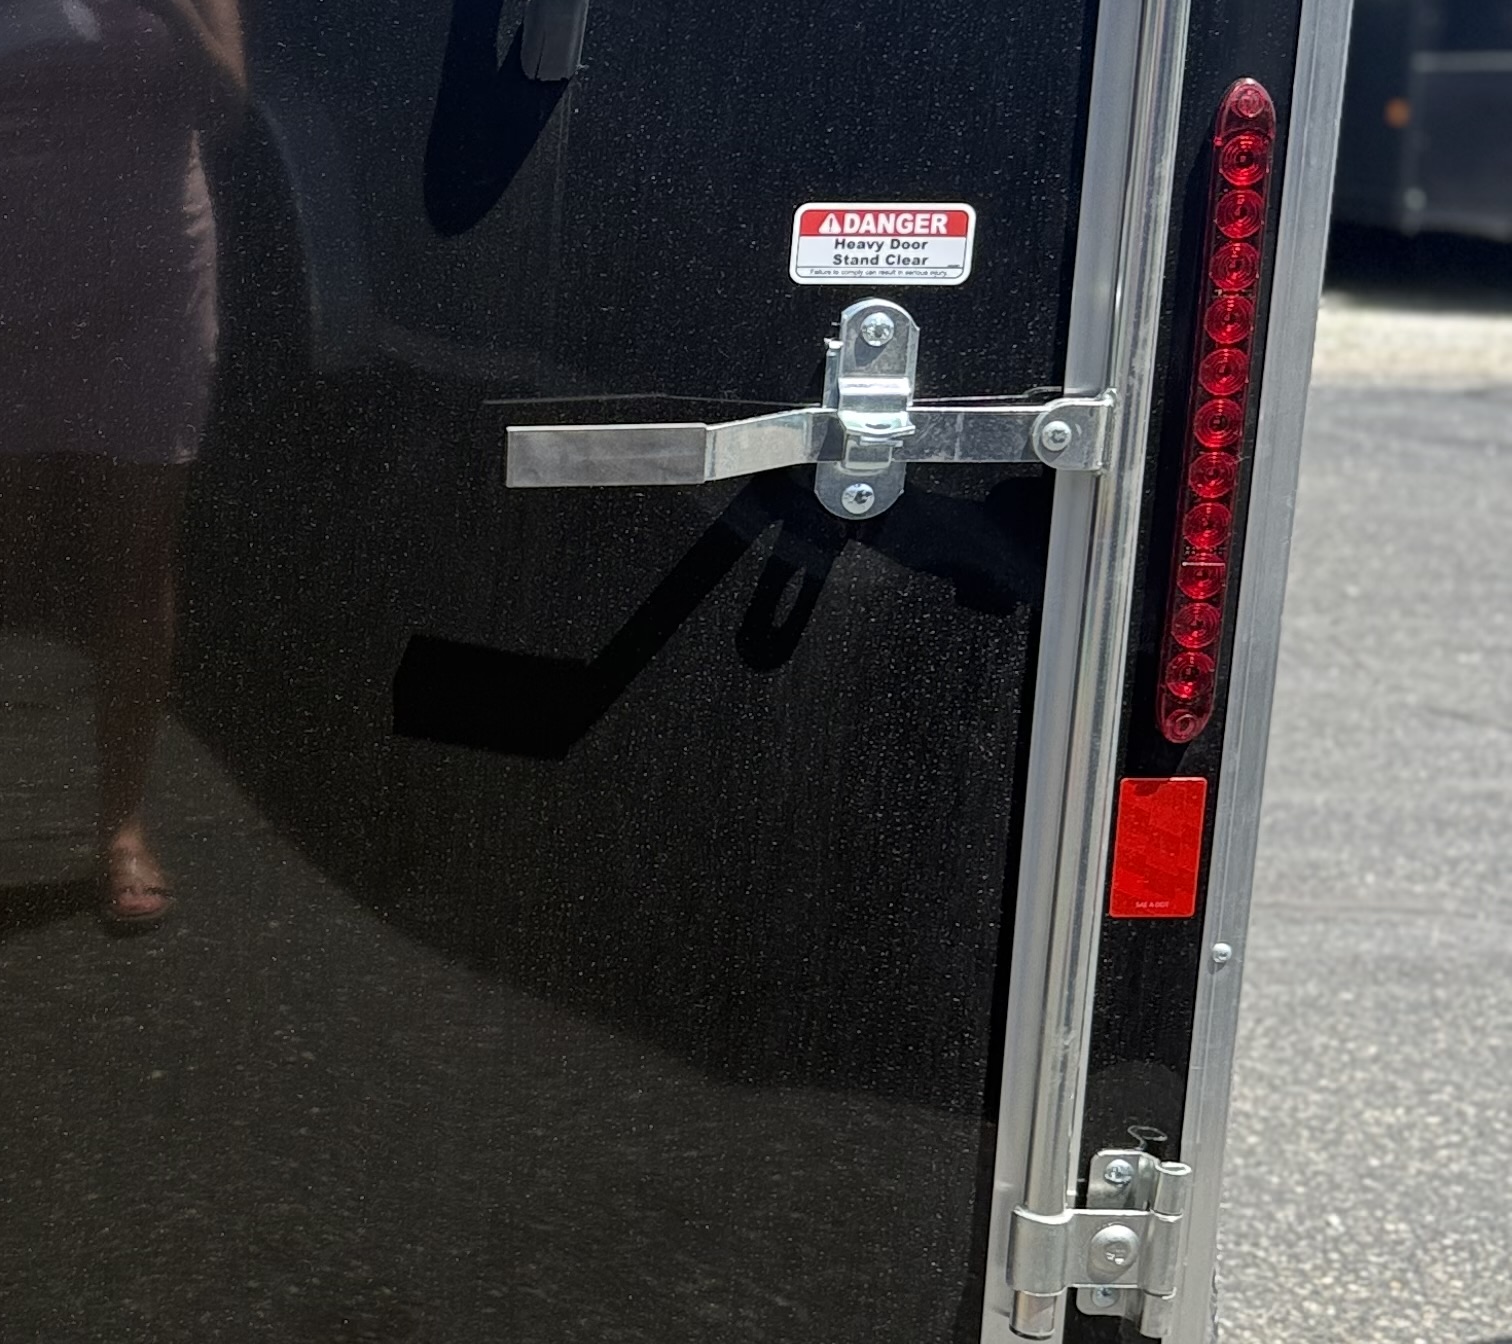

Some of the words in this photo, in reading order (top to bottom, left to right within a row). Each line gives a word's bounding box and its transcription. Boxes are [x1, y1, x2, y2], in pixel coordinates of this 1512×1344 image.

[843, 213, 949, 235] DANGER
[834, 238, 884, 253] Heavy
[890, 238, 929, 250] Door
[832, 254, 880, 266] Stand
[885, 254, 929, 266] Clear
